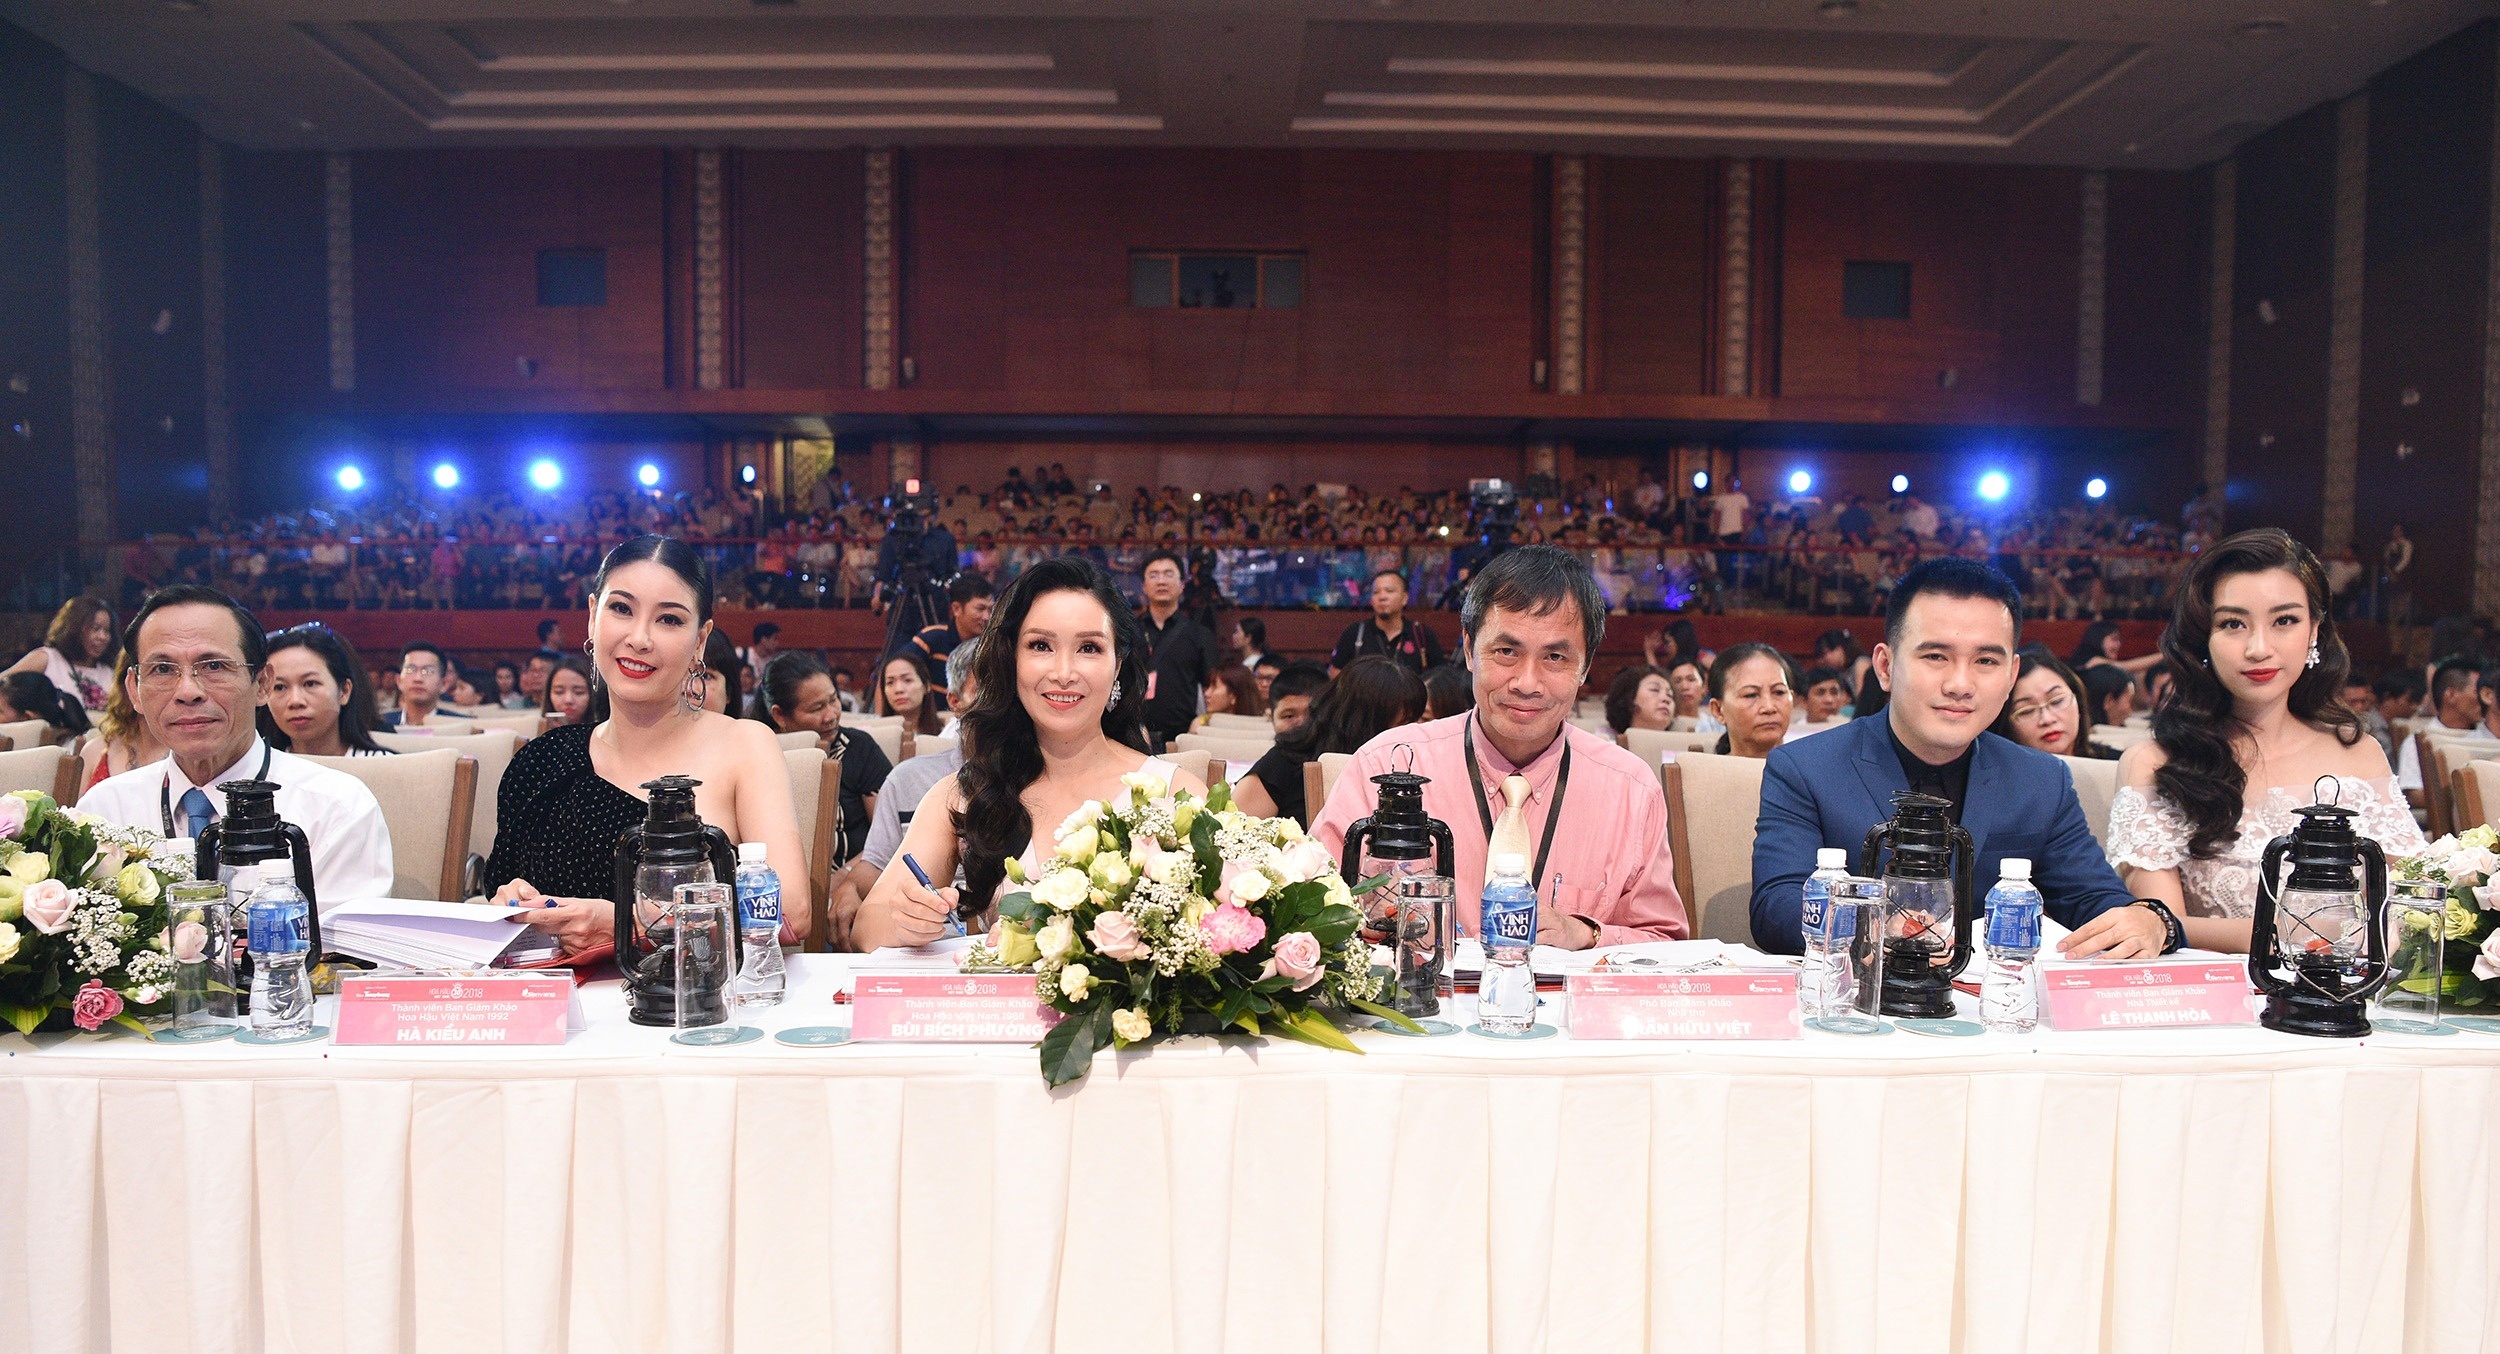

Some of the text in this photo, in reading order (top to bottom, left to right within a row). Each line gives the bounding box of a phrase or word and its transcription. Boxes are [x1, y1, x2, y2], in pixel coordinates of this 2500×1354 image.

[2154, 973, 2172, 984] 2018
[462, 987, 483, 999] 2018
[976, 983, 998, 995] 2018
[1691, 982, 1712, 993] 2018
[2095, 986, 2206, 999] Thành viên Ban Giám Khảo
[391, 1002, 518, 1012] Thành viên Ban Giám Khảo
[905, 1000, 934, 1008] Thành
[937, 1000, 959, 1008] viên
[960, 1000, 978, 1008] Ban
[981, 1000, 1006, 1008] Giám
[1639, 999, 1658, 1007] Phó
[1660, 999, 1679, 1007] Ban
[1708, 998, 1732, 1007] Khảo
[2126, 999, 2145, 1008] Nhà
[2146, 997, 2168, 1008] Thiết
[397, 1011, 509, 1023] Hoa Hậu Việt Nam 1992
[911, 1012, 931, 1021] Hoa
[977, 1012, 1000, 1021] Nam
[1667, 1008, 1687, 1018] Nhà
[2101, 1008, 2212, 1025] LÊ THANH HÒA
[397, 1025, 422, 1041] HÀ
[468, 1027, 507, 1041] ANH
[923, 1021, 965, 1037] BÍCH
[1672, 1020, 1711, 1035] HỮU
[1713, 1019, 1753, 1038] VIỆT
